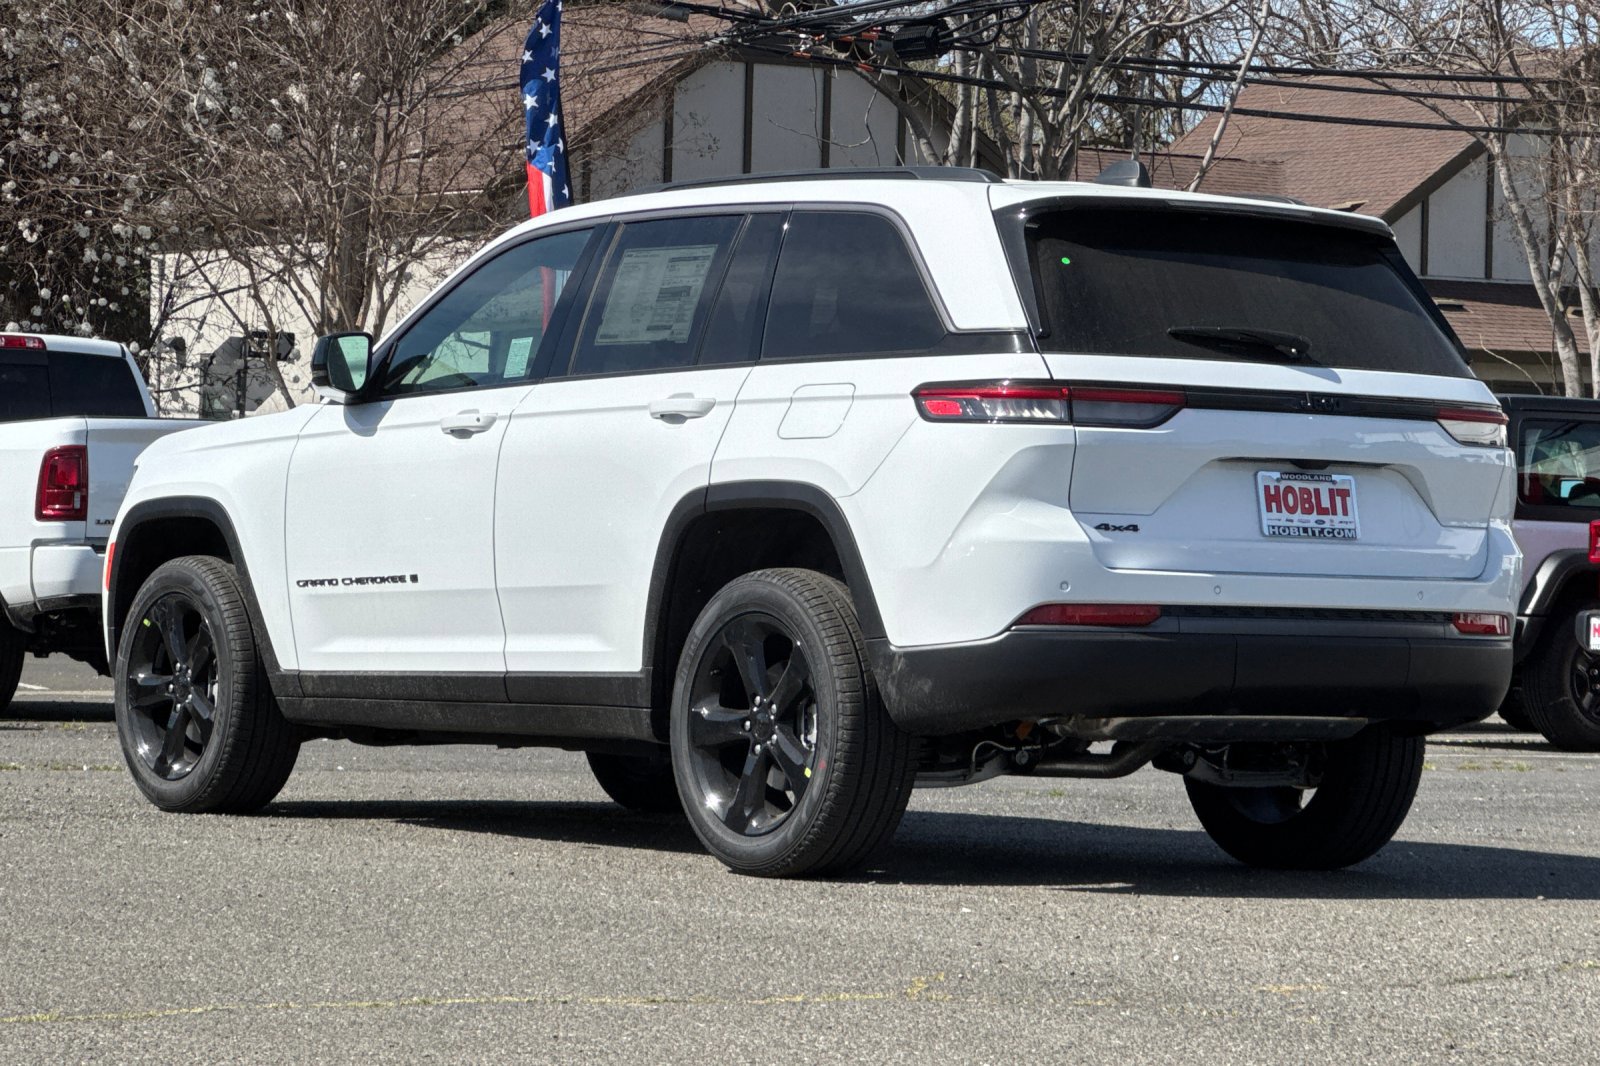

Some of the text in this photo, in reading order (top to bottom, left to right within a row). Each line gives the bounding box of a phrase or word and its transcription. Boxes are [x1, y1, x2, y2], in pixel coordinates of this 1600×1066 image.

[1281, 473, 1332, 481] WOODLAND
[1264, 485, 1351, 516] HOBLIT
[1094, 523, 1139, 532] 4x4
[1269, 526, 1357, 538] HOBLIT.COM
[296, 575, 407, 587] GRAND CHEROKEE
